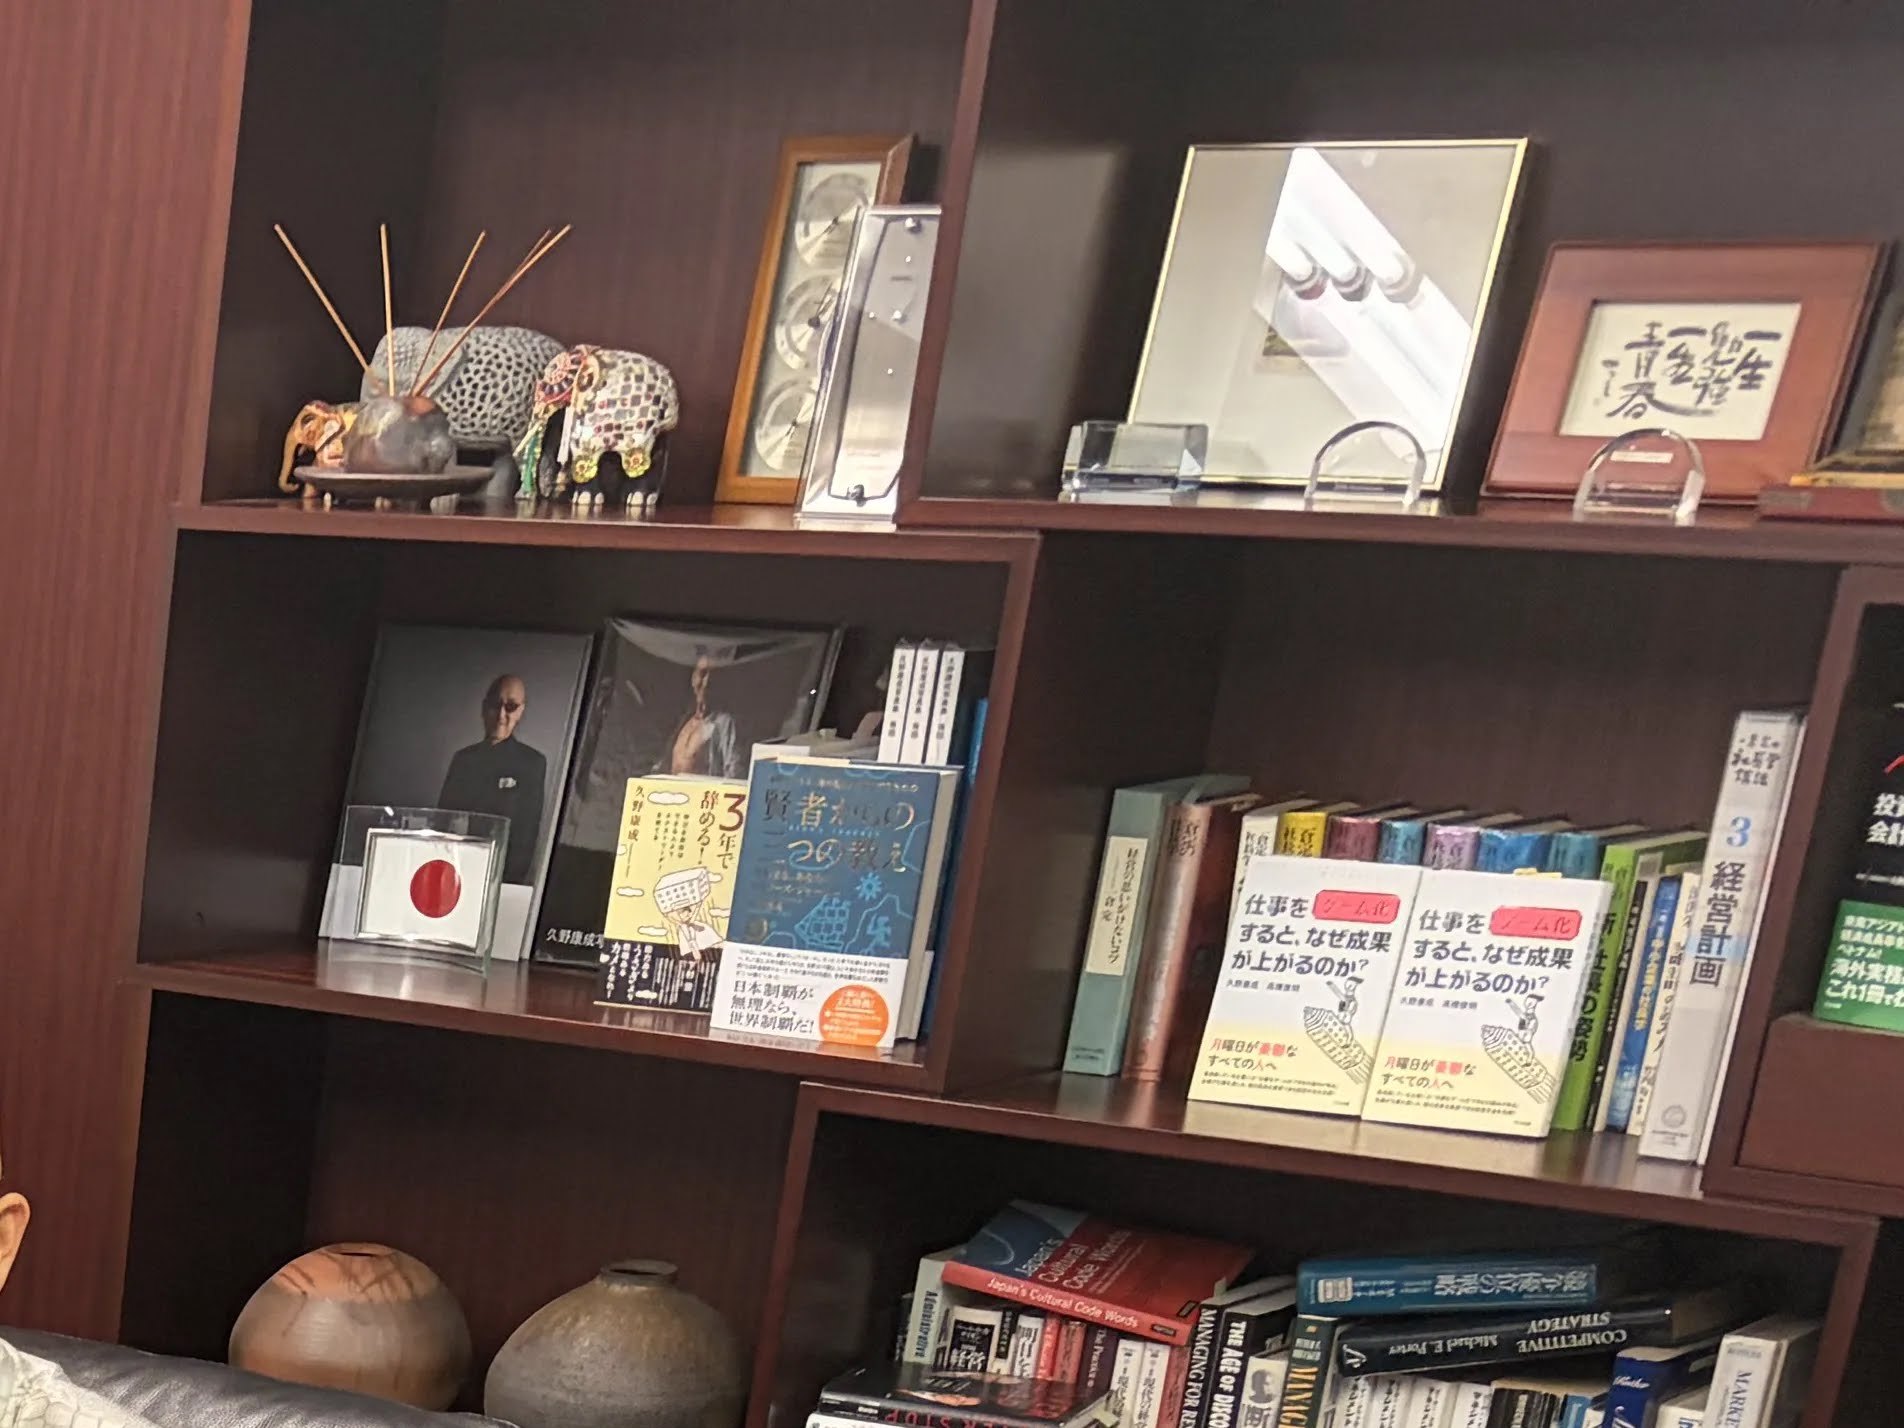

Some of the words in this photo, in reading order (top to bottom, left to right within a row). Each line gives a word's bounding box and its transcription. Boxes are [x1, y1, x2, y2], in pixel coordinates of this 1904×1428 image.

[627, 785, 644, 841] 久野康成
[716, 793, 746, 870] 3年で
[1726, 816, 1752, 847] 3
[1245, 893, 1309, 919] 仕事を
[1418, 908, 1485, 933] 仕事を
[1689, 860, 1746, 987] 経営計画
[1239, 924, 1392, 953] すると、なぜ成果
[1412, 938, 1574, 971] すると、なぜ成果
[1207, 1054, 1277, 1071] すべての人へ
[1381, 1074, 1455, 1091] すべての人へ
[987, 1278, 1028, 1297] Japan's
[1029, 1286, 1073, 1310] Cultural
[1073, 1299, 1103, 1318] Code
[1103, 1307, 1138, 1328] Words
[1228, 1321, 1247, 1347] THE
[1527, 1311, 1612, 1334] STRATEGY
[1189, 1309, 1218, 1381] MANAGING
[1389, 1340, 1427, 1357] Porter
[1446, 1334, 1499, 1353] Michael
[1516, 1328, 1627, 1353] COMPETITIVE
[1221, 1347, 1243, 1373] AGE
[1183, 1382, 1202, 1407] FOR
